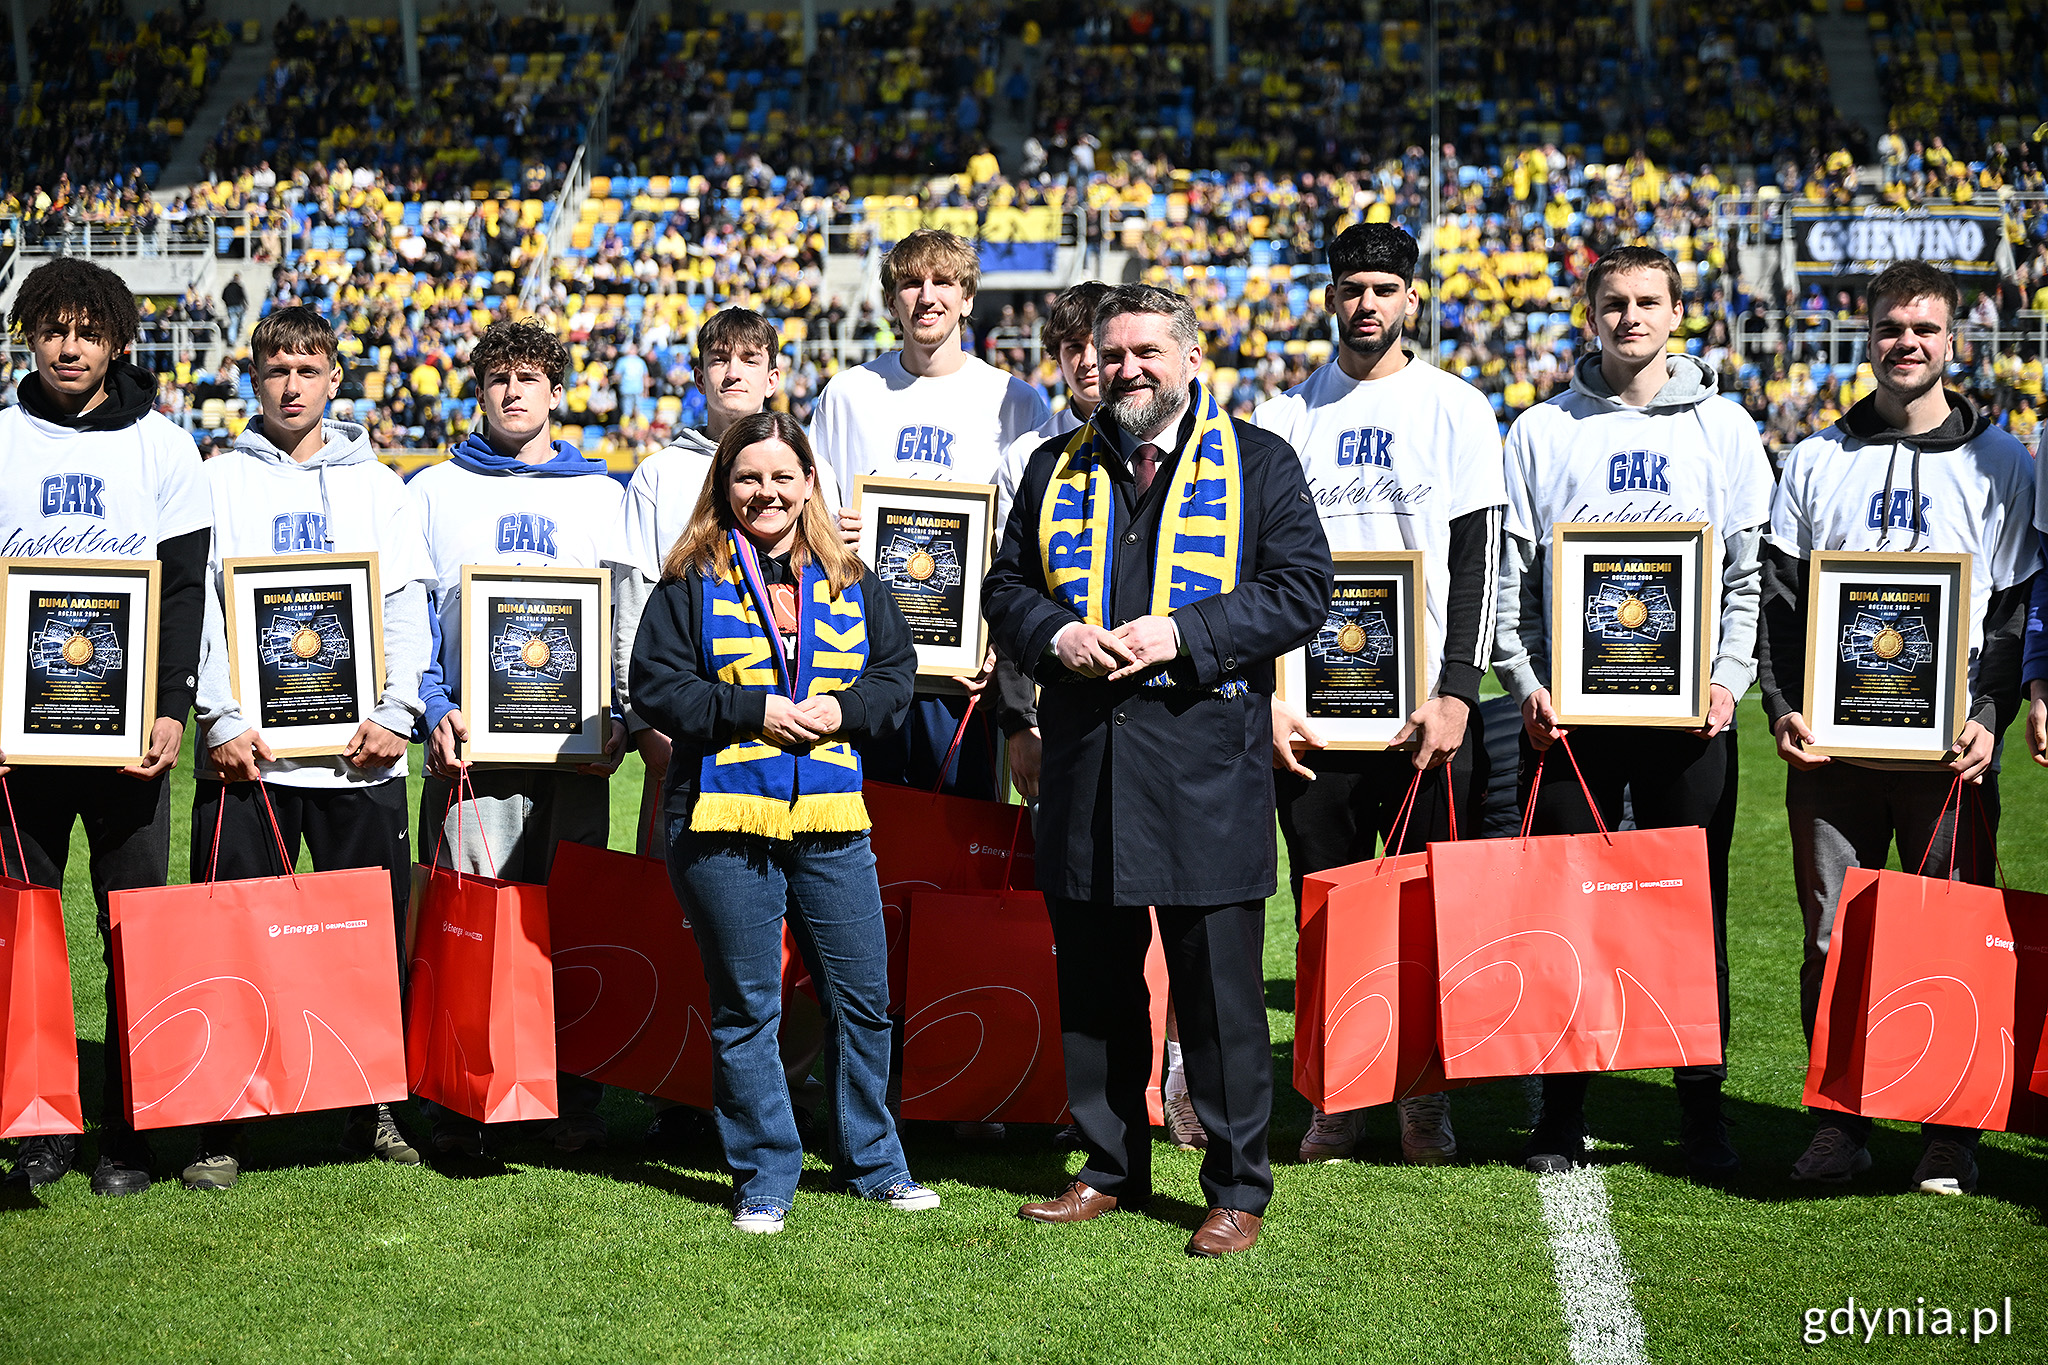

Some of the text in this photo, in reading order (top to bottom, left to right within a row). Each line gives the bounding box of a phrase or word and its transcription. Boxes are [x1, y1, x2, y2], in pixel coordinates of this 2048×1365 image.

[894, 424, 956, 470] GAK
[1335, 426, 1395, 471] GAK
[1606, 449, 1671, 495] GAK
[40, 473, 106, 519] GAK
[1865, 488, 1932, 536] GAK
[886, 514, 960, 529] DUMA AKADEMII
[272, 512, 335, 554] GAK
[495, 512, 558, 559] GAK
[1, 525, 147, 557] basketball
[1592, 562, 1672, 573] DUMA AKADEMII
[263, 591, 343, 605] DUMA AKADEMII
[1342, 588, 1389, 598] AKADEMII
[1849, 591, 1931, 603] DUMA AKADEMII
[38, 597, 120, 610] DUMA AKADEMII
[497, 603, 573, 615] DUMA AKADEMII
[981, 845, 1011, 859] Energa
[1597, 881, 1634, 893] Energa
[283, 923, 320, 935] Energa
[447, 923, 463, 937] Energa
